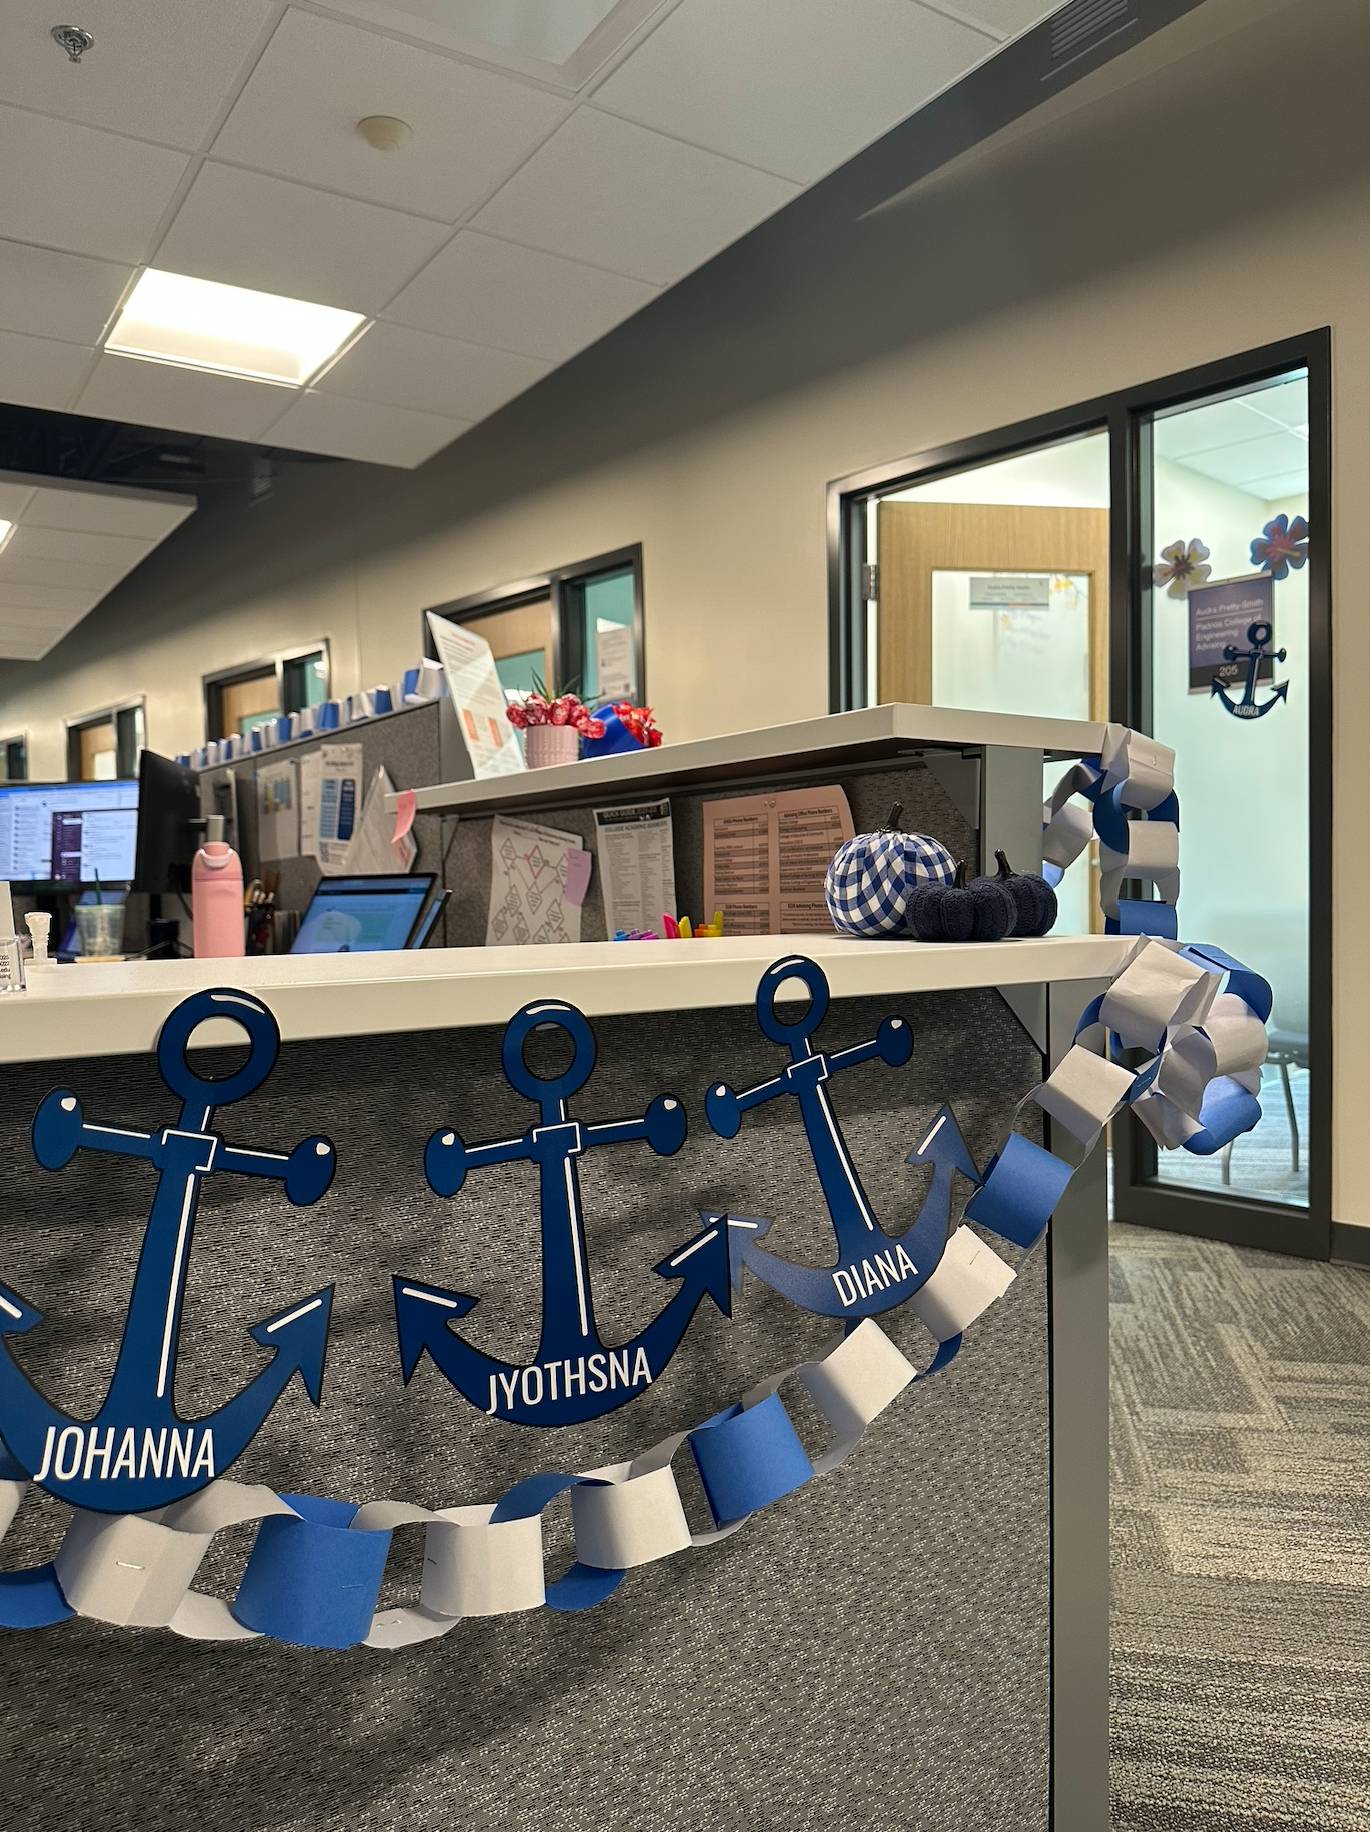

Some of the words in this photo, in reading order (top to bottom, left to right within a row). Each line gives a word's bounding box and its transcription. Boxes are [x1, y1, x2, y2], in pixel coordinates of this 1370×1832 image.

[1195, 607, 1218, 617] Audra
[1223, 617, 1252, 629] College
[1195, 630, 1239, 643] Engineering
[1195, 641, 1227, 652] Advising
[1219, 664, 1239, 677] 205
[1232, 705, 1260, 717] AUDRA
[832, 1243, 919, 1307] DIANA
[485, 1346, 653, 1415] JYOTHSNA
[32, 1425, 216, 1482] JOHANNA
